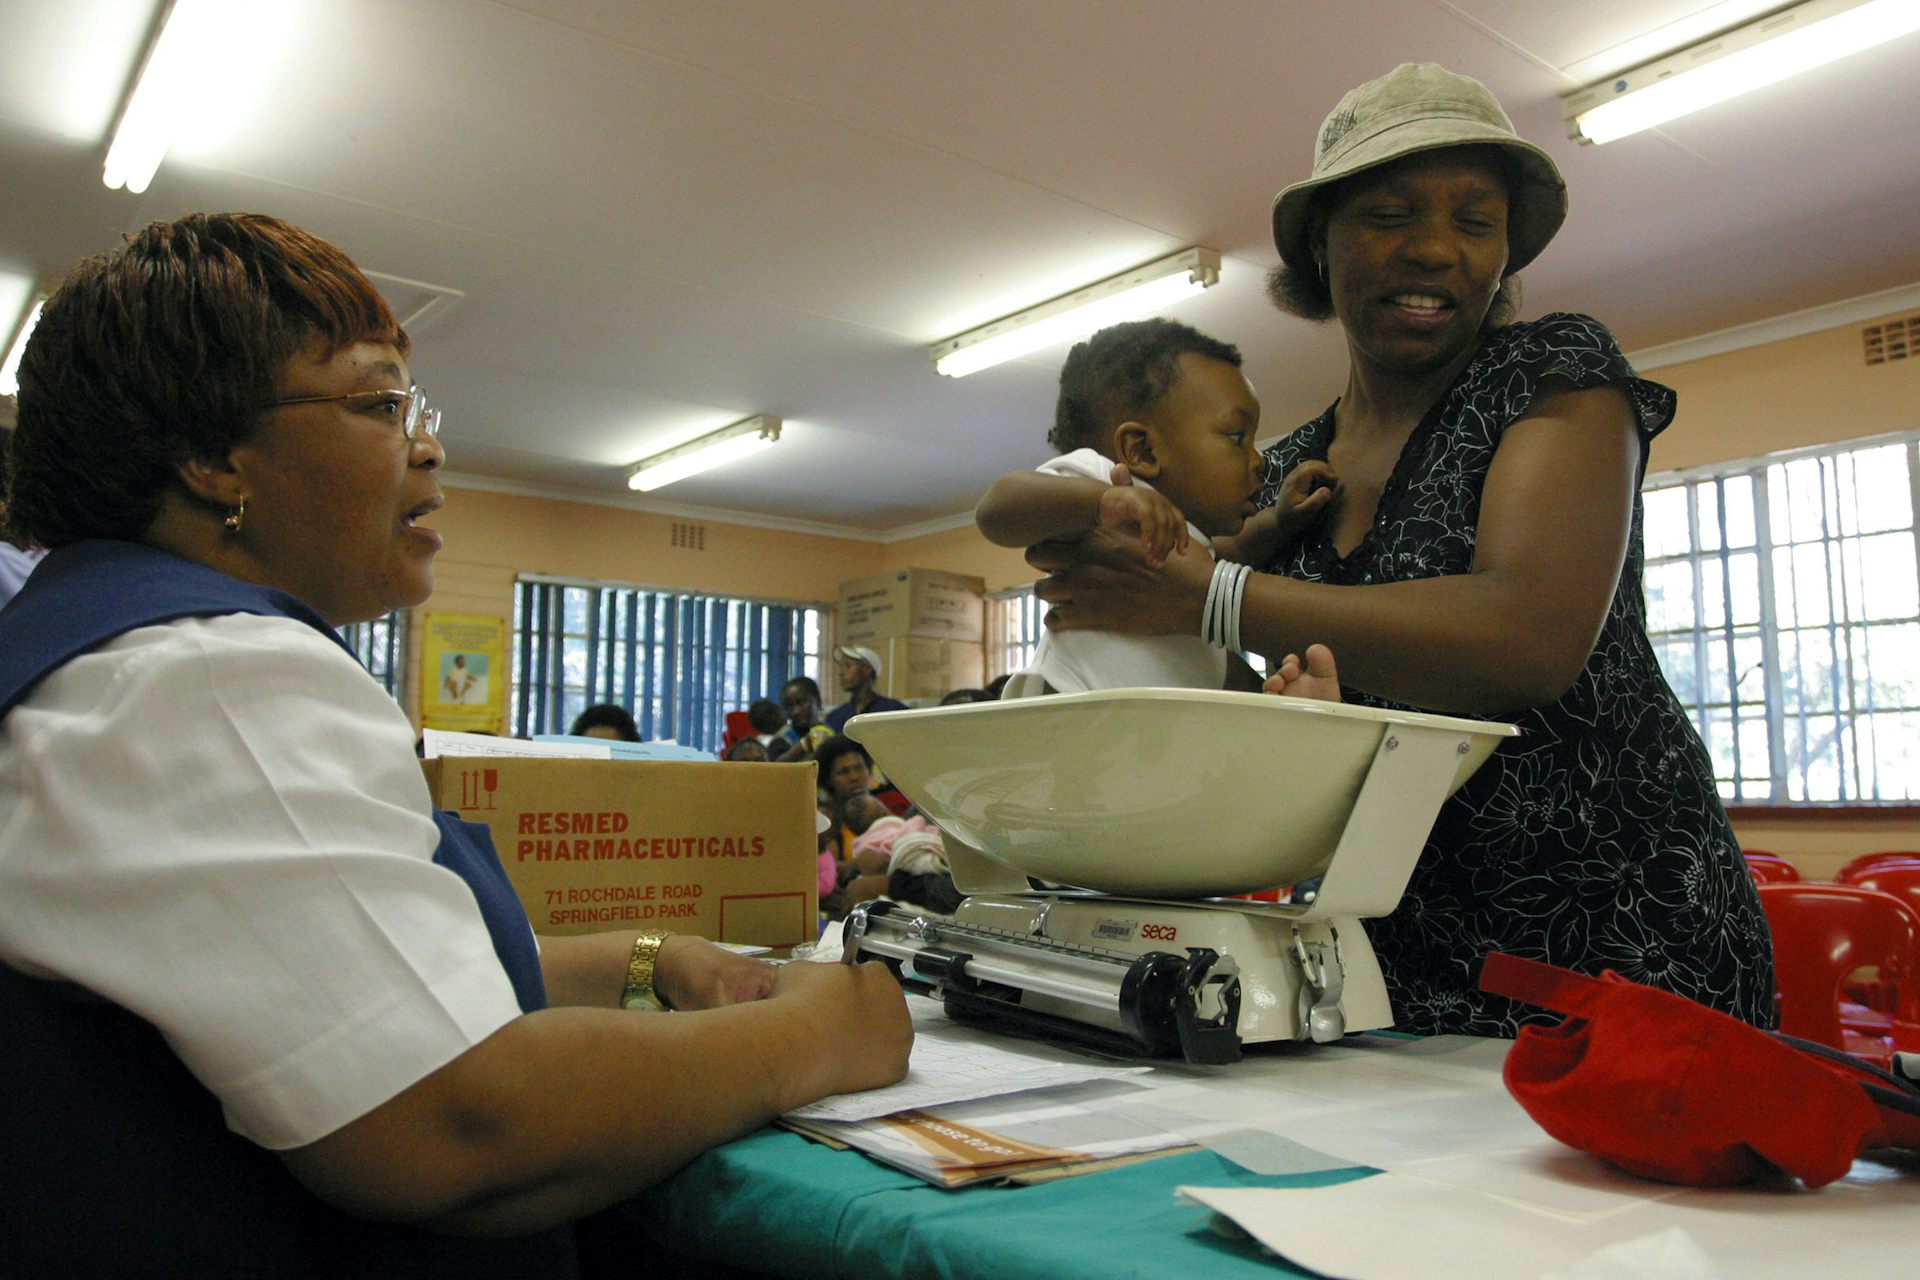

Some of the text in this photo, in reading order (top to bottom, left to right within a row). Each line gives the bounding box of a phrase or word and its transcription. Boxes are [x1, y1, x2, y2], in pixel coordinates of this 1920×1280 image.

[518, 812, 628, 834] RESMED
[518, 837, 764, 861] PHARMACEUTICALS
[545, 884, 703, 905] 71 ROCHDALE ROAD
[550, 903, 697, 925] SPRINGFIELD PARK
[1141, 924, 1177, 941] seca
